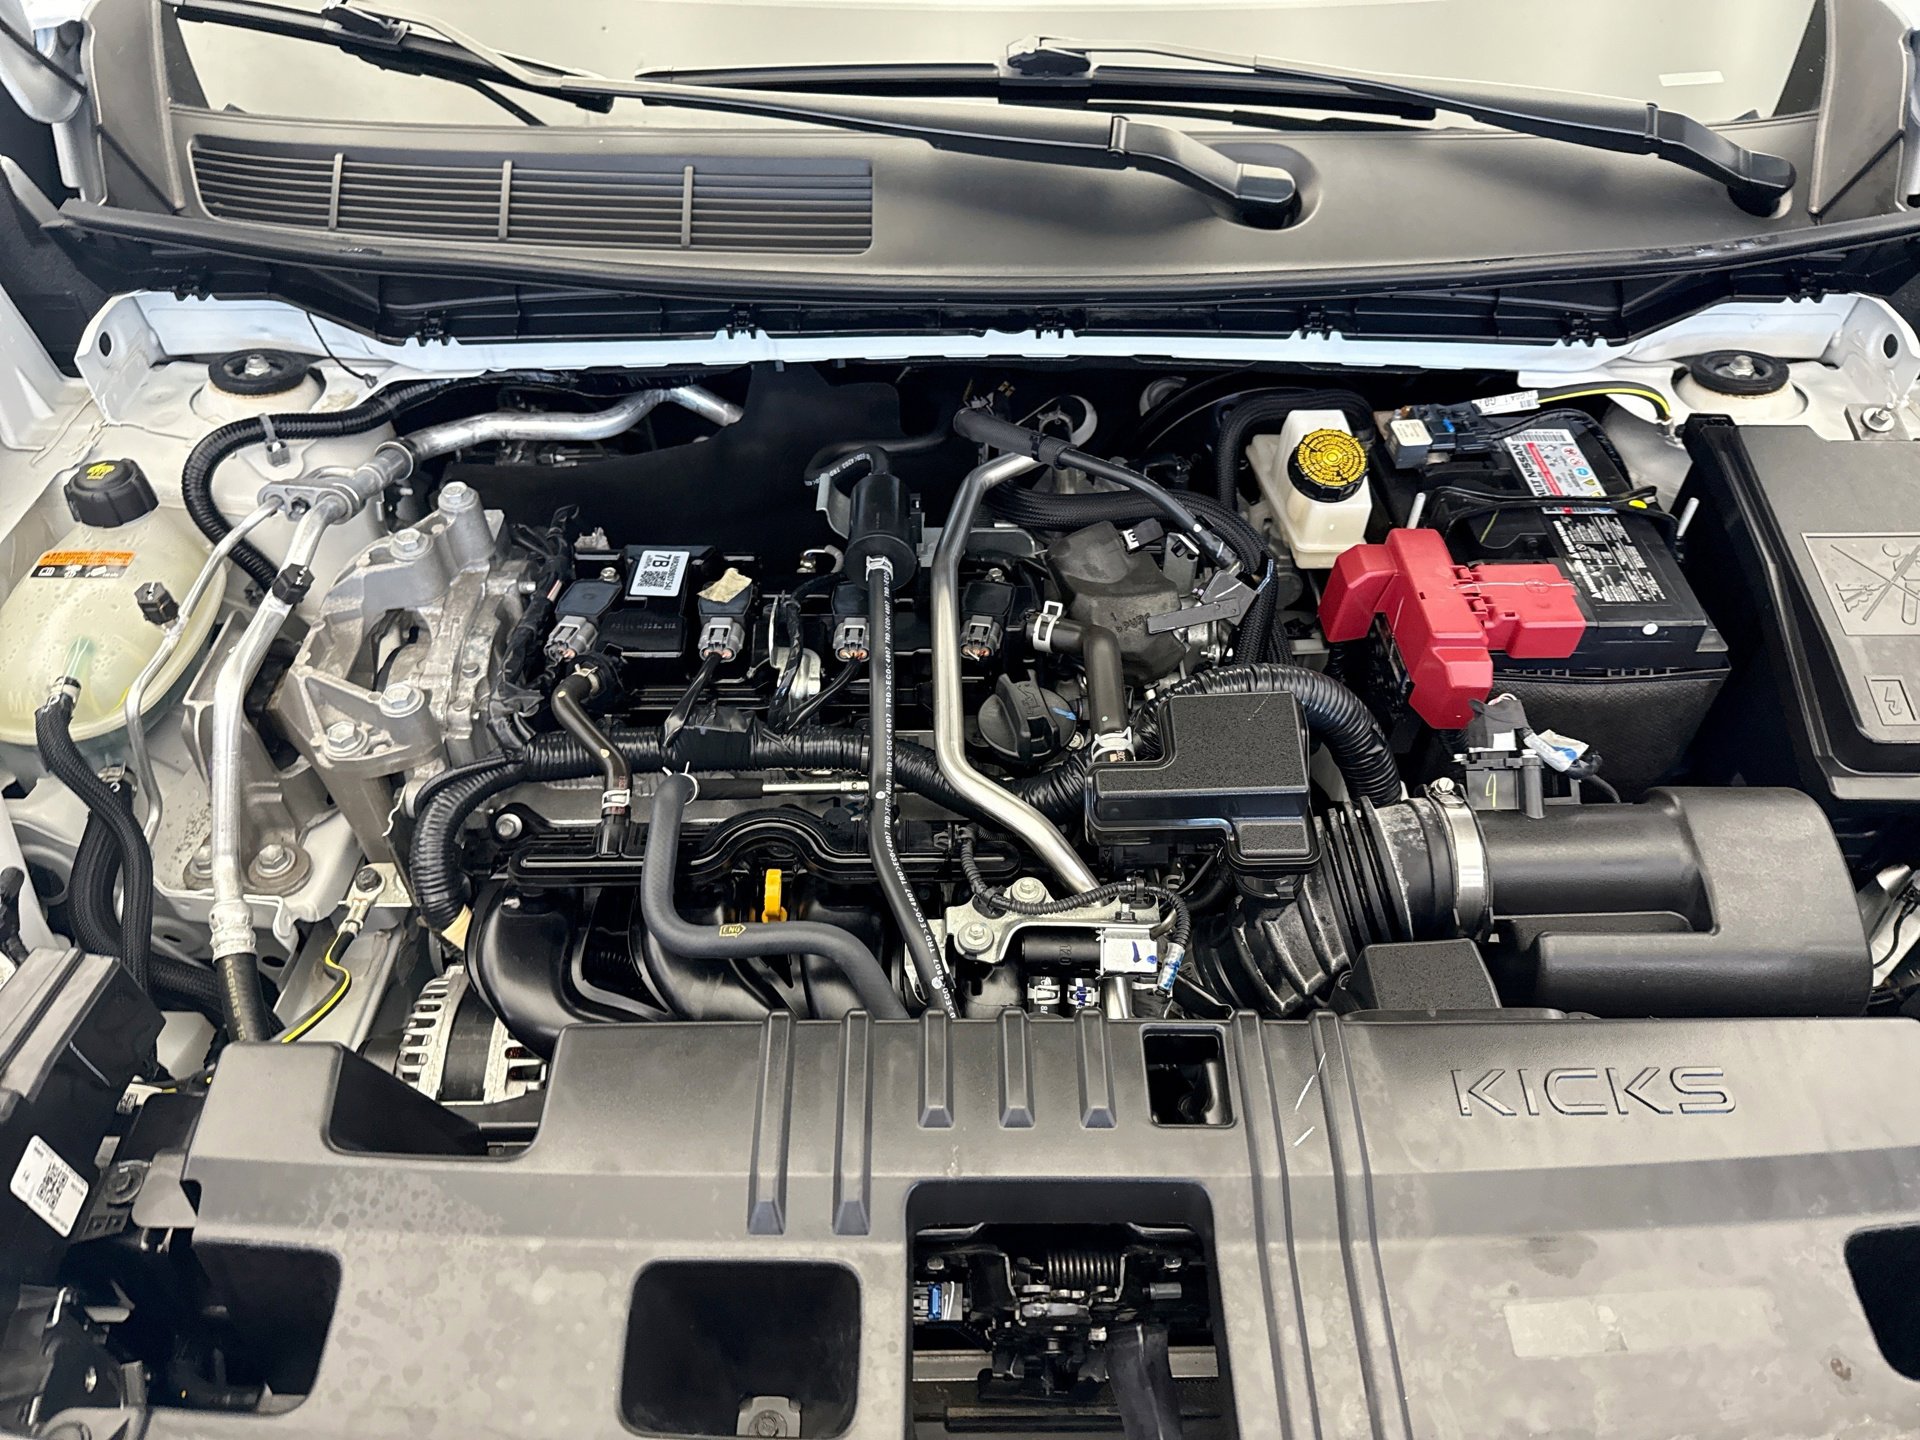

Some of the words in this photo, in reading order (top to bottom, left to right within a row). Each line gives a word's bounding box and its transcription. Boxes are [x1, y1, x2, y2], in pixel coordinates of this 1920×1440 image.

[1510, 443, 1538, 478] NISSAN
[652, 554, 672, 568] 7B
[885, 713, 893, 776] TRD>ECO<4807
[1451, 1066, 1737, 1117] KICKS
